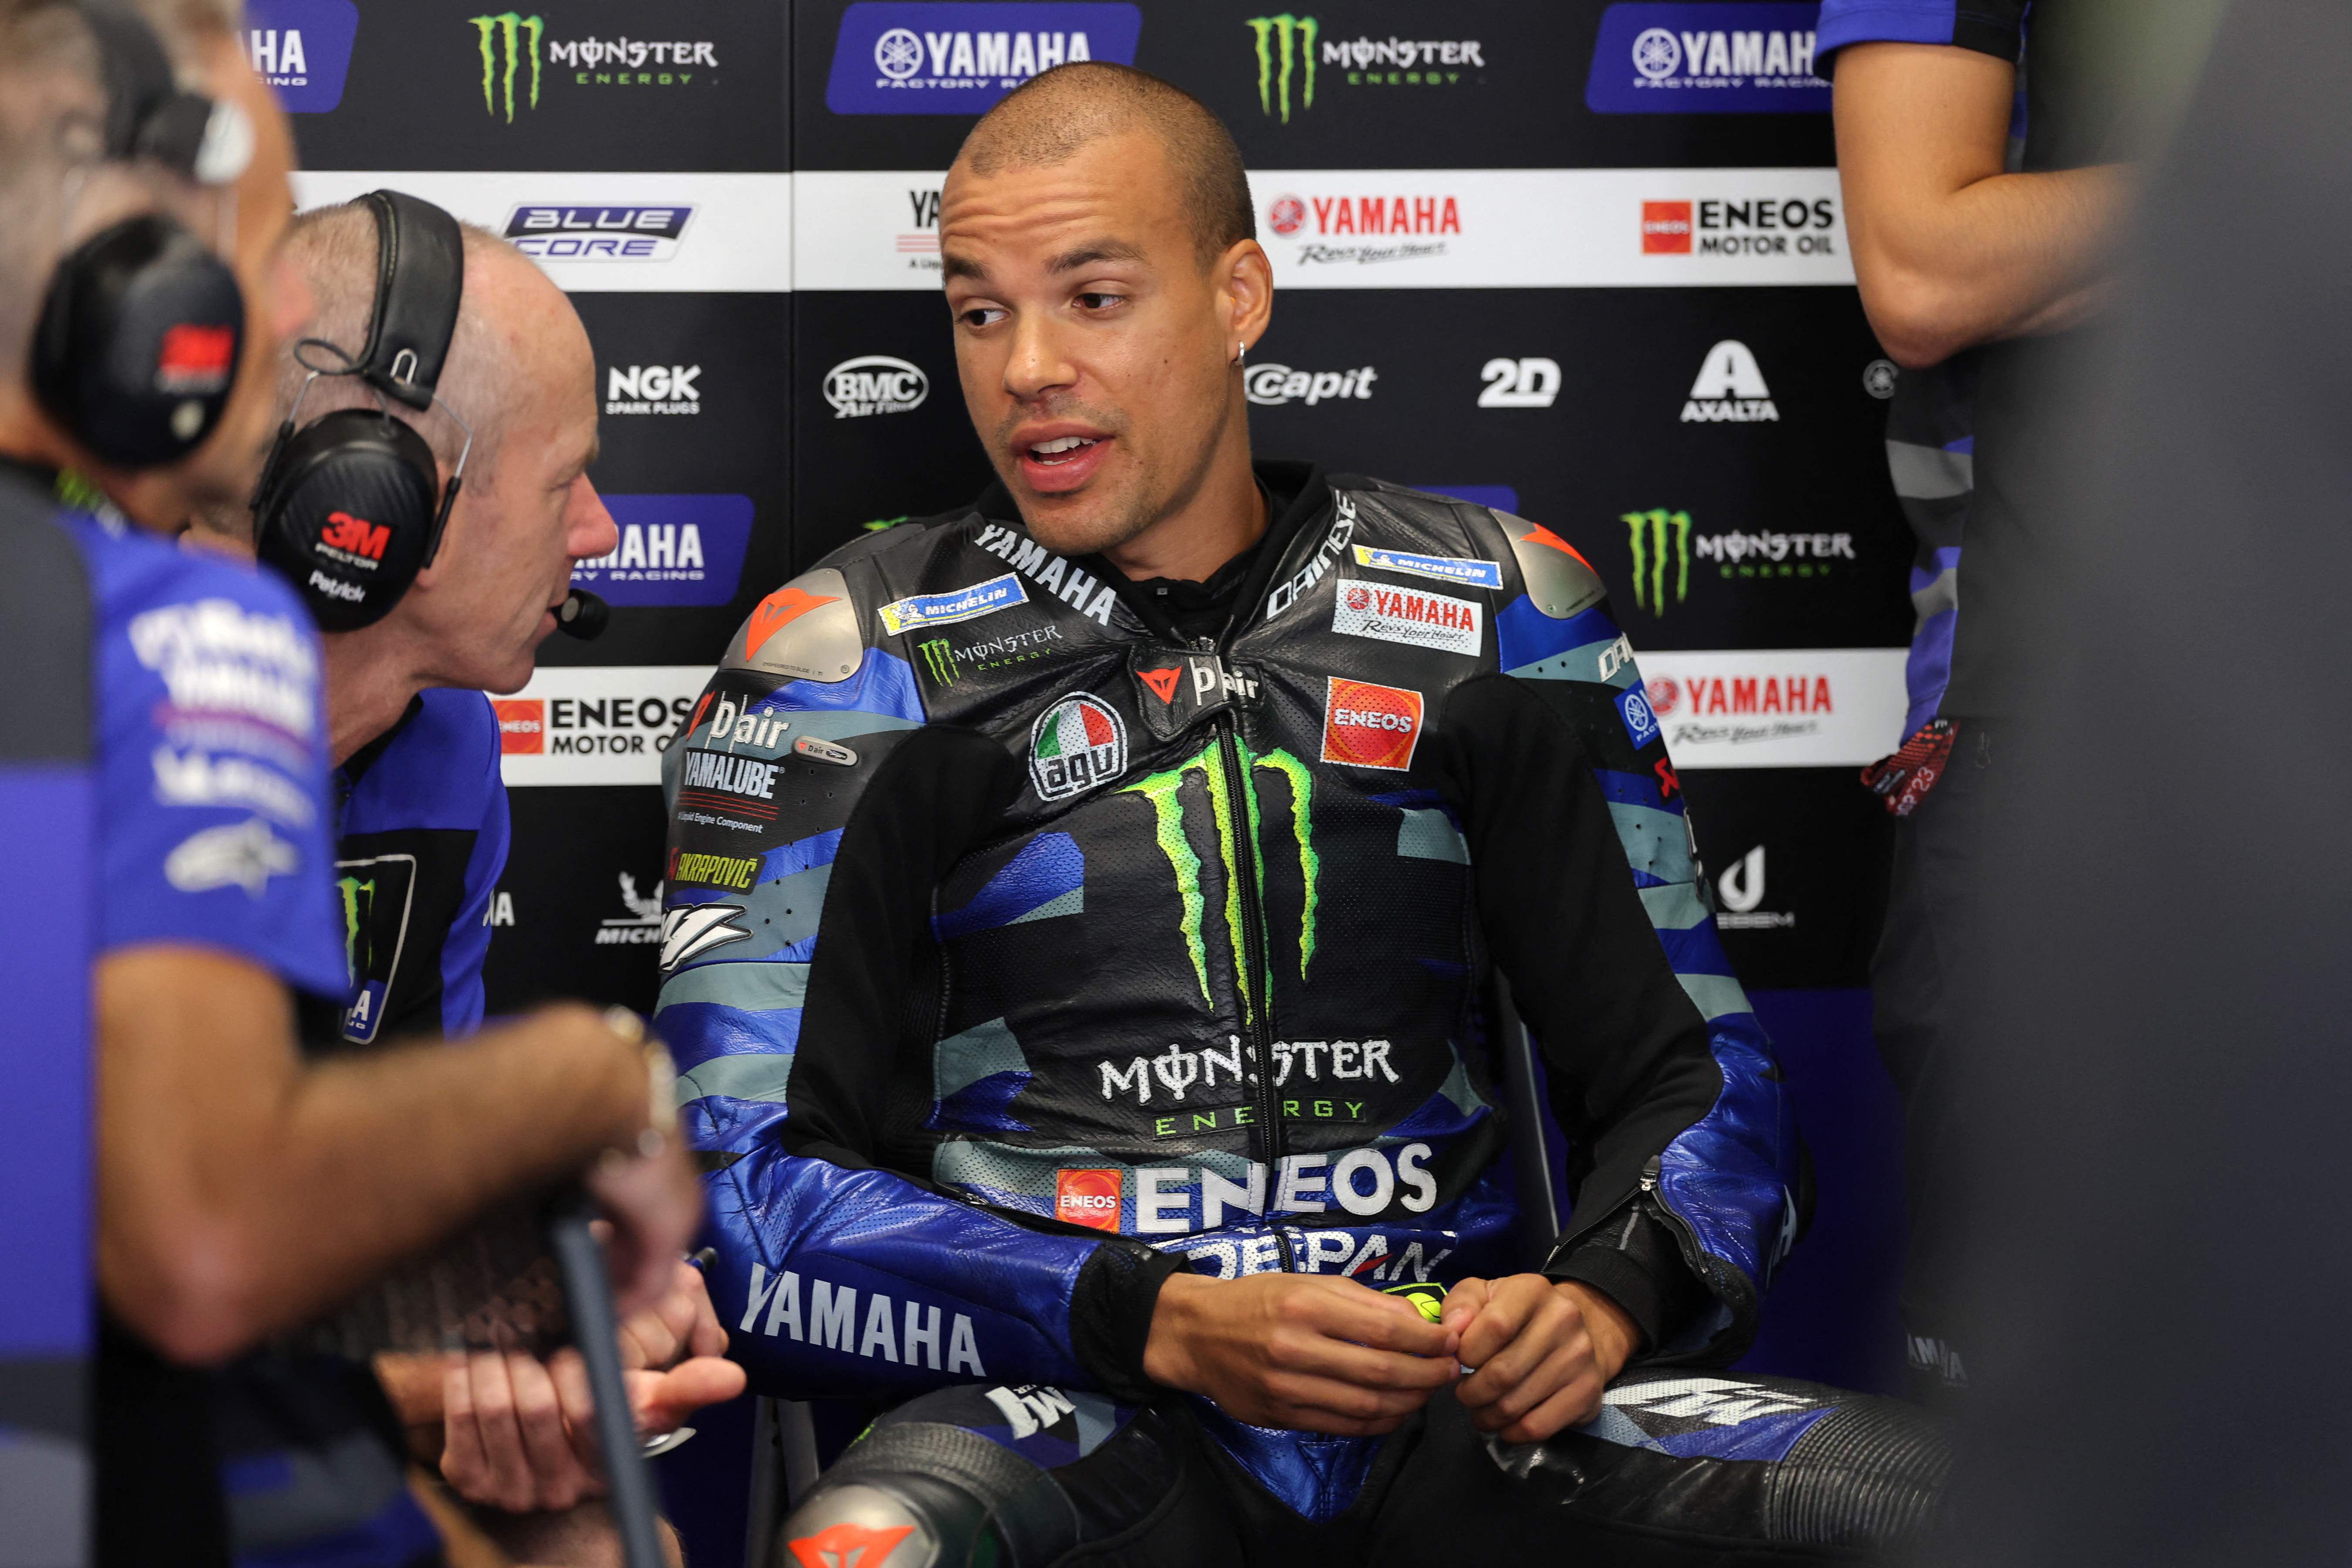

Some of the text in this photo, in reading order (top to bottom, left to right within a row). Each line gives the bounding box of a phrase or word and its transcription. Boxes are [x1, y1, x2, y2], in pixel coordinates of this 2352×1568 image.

[549, 36, 718, 69] MONSTER
[925, 31, 1091, 77] YAMAHA
[1322, 37, 1485, 70] MONSTER
[576, 73, 692, 85] ENERGY
[876, 78, 990, 88] FACTORY
[1348, 71, 1459, 85] ENERGY
[523, 209, 674, 229] BLUE
[1312, 196, 1462, 235] YAMAHA
[1644, 220, 1690, 235] ENEOS
[1700, 199, 1834, 229] ENEOS
[516, 239, 657, 256] CORE
[1700, 236, 1835, 257] MOTOR OIL
[608, 365, 702, 401] NGK
[835, 372, 918, 402] BMC
[1477, 357, 1562, 408] 2D
[606, 401, 700, 415] SPARK PLUGS
[1680, 400, 1780, 422] AXALTA
[322, 511, 391, 561] 3M
[1695, 529, 1857, 563] MONSTER
[610, 570, 706, 581] RACING
[974, 523, 1117, 626] YAMAHA
[1396, 559, 1486, 578] MICHELIN
[309, 569, 366, 603] Patrick
[925, 587, 1008, 616] MICHELIN
[1375, 590, 1474, 632] YAMAHA
[1360, 619, 1403, 634] Revs
[955, 625, 1064, 662] MONSTER
[977, 648, 1051, 671] ENERGY
[1686, 674, 1834, 715] YAMAHA
[551, 698, 692, 728] ENEOS
[1334, 708, 1413, 734] ENEOS
[551, 736, 644, 755] MOTOR
[684, 752, 779, 799] YAMALUBE
[694, 813, 716, 825] Engine
[716, 816, 763, 834] Component
[1098, 1034, 1400, 1106] MONSTER
[1155, 1100, 1365, 1136] ENERGY
[1060, 1193, 1116, 1210] ENEOS
[1136, 1142, 1437, 1234] ENEOS
[739, 1262, 987, 1377] YAMAHA
